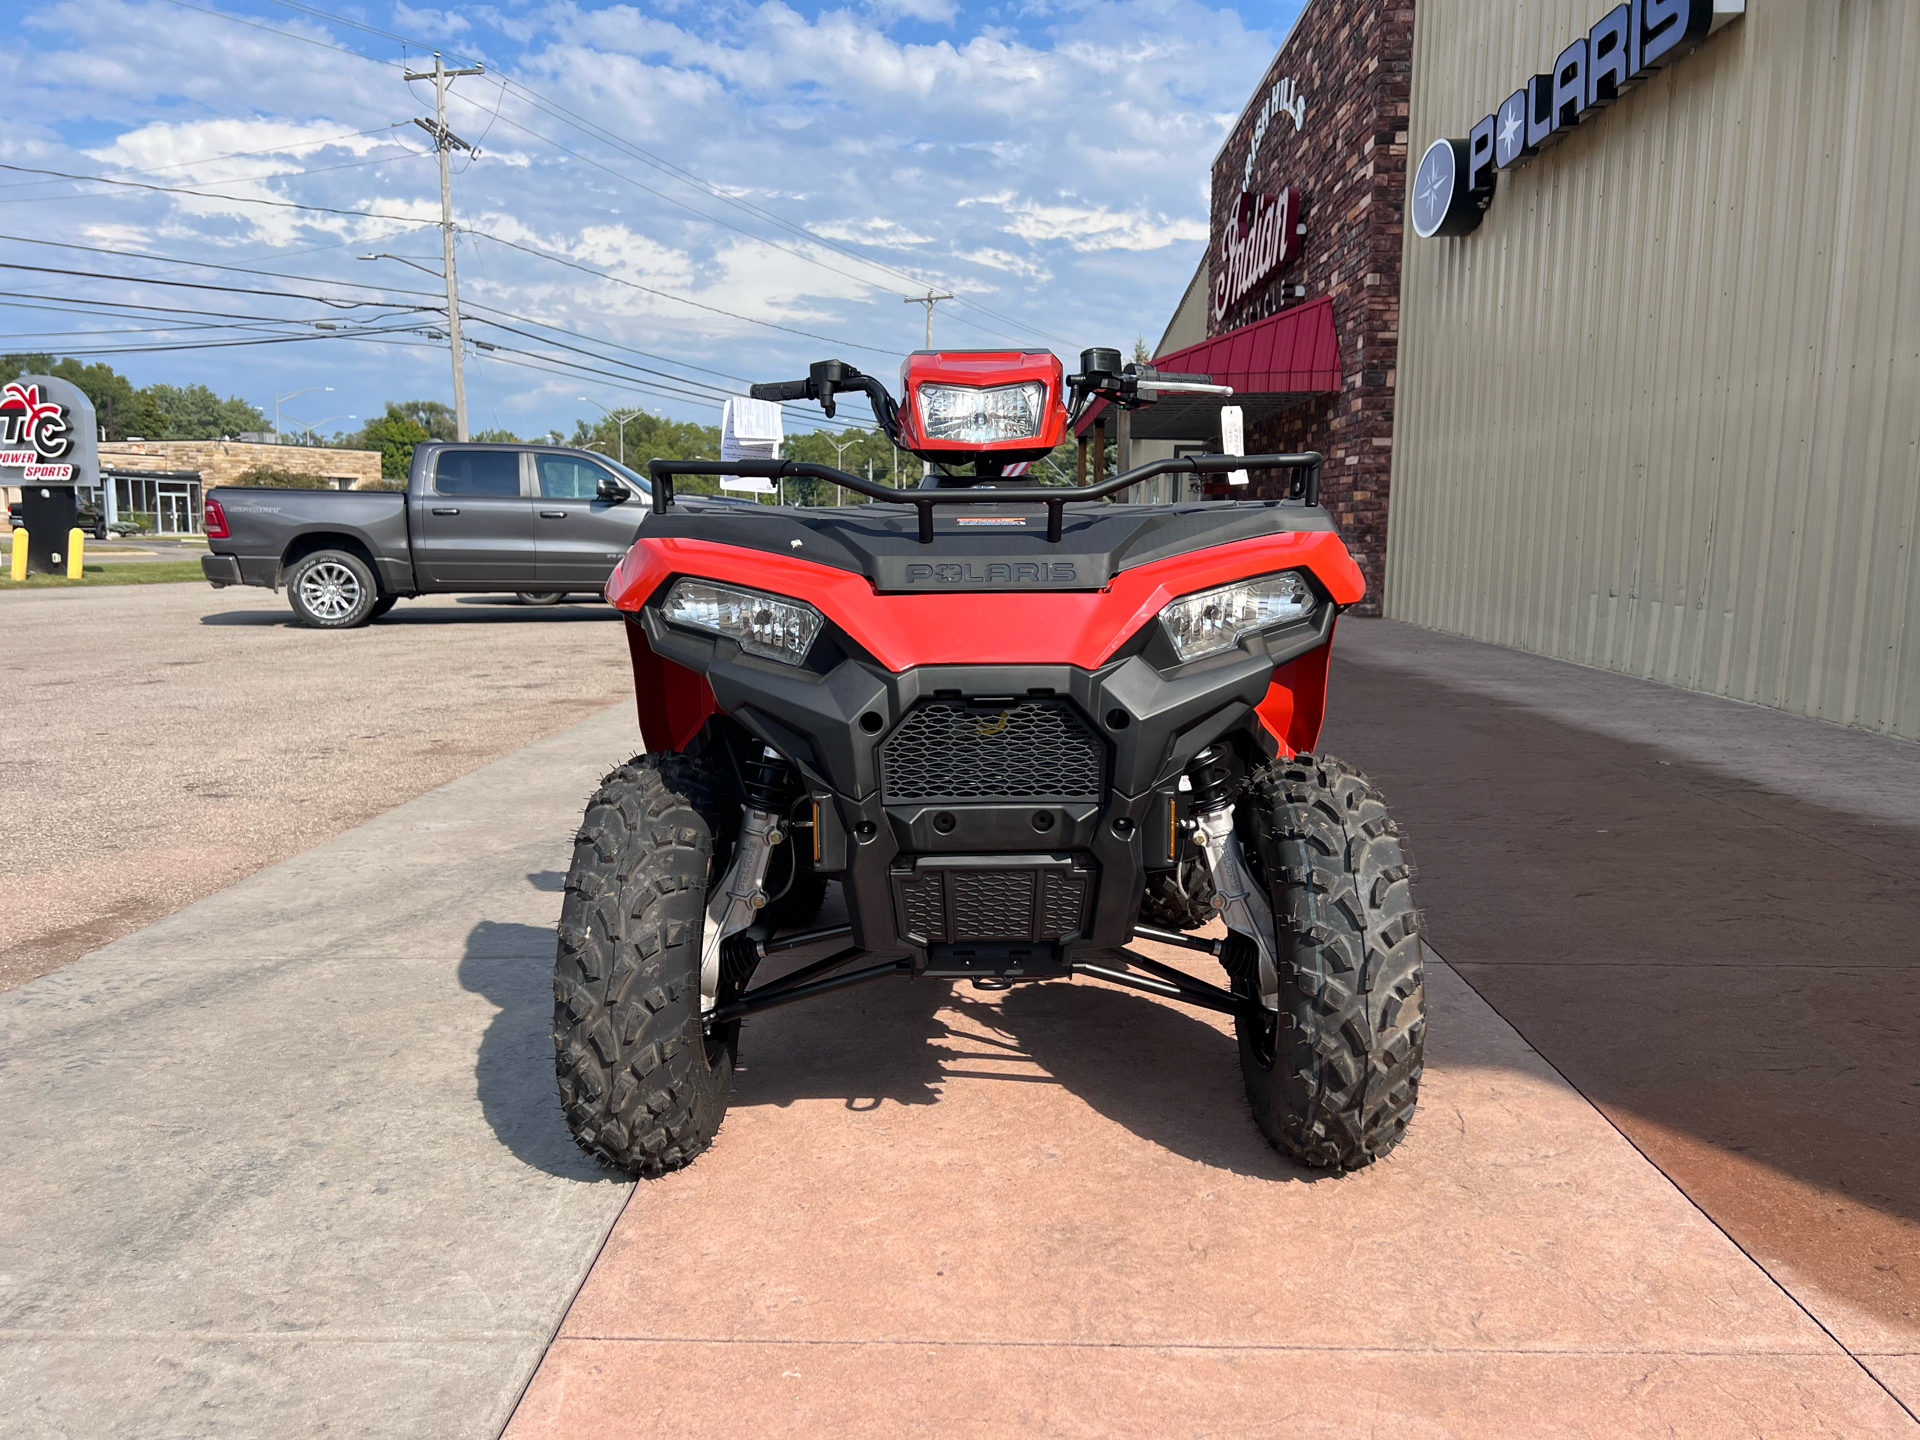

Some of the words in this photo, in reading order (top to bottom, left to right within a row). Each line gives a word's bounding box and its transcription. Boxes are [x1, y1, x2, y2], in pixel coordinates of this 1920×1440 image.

[1271, 77, 1306, 131] HILLS
[1468, 0, 1691, 192] POLARIS
[1215, 187, 1289, 322] Indian
[26, 466, 70, 477] SPORTS
[906, 562, 1076, 583] POLARIS
[737, 841, 757, 891] POLARIS
